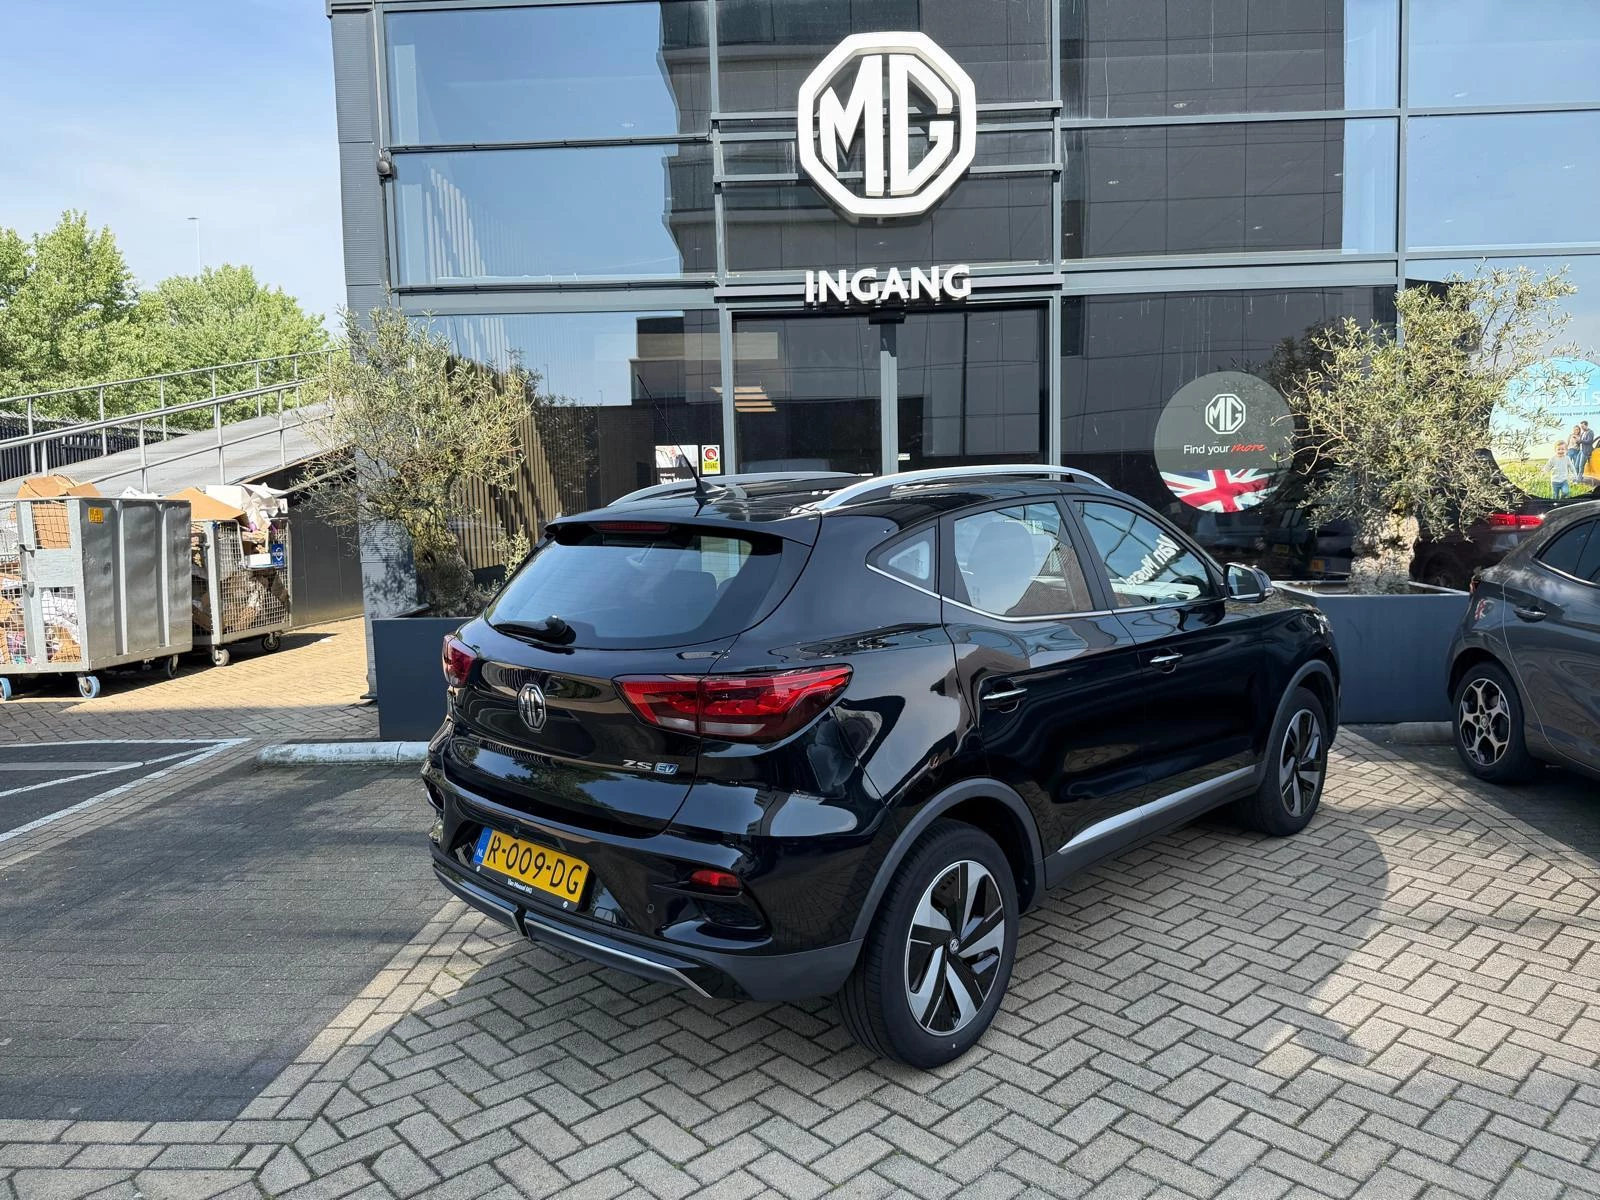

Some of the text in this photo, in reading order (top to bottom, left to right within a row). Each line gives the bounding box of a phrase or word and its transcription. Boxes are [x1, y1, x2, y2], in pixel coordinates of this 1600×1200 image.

[818, 54, 955, 197] MG
[805, 264, 972, 303] INGANG
[1208, 397, 1243, 431] MG
[1183, 443, 1266, 456] Find your more
[519, 685, 545, 730] MG
[623, 759, 679, 775] ZS EV
[476, 848, 484, 858] NL
[487, 835, 582, 895] R-009-DG
